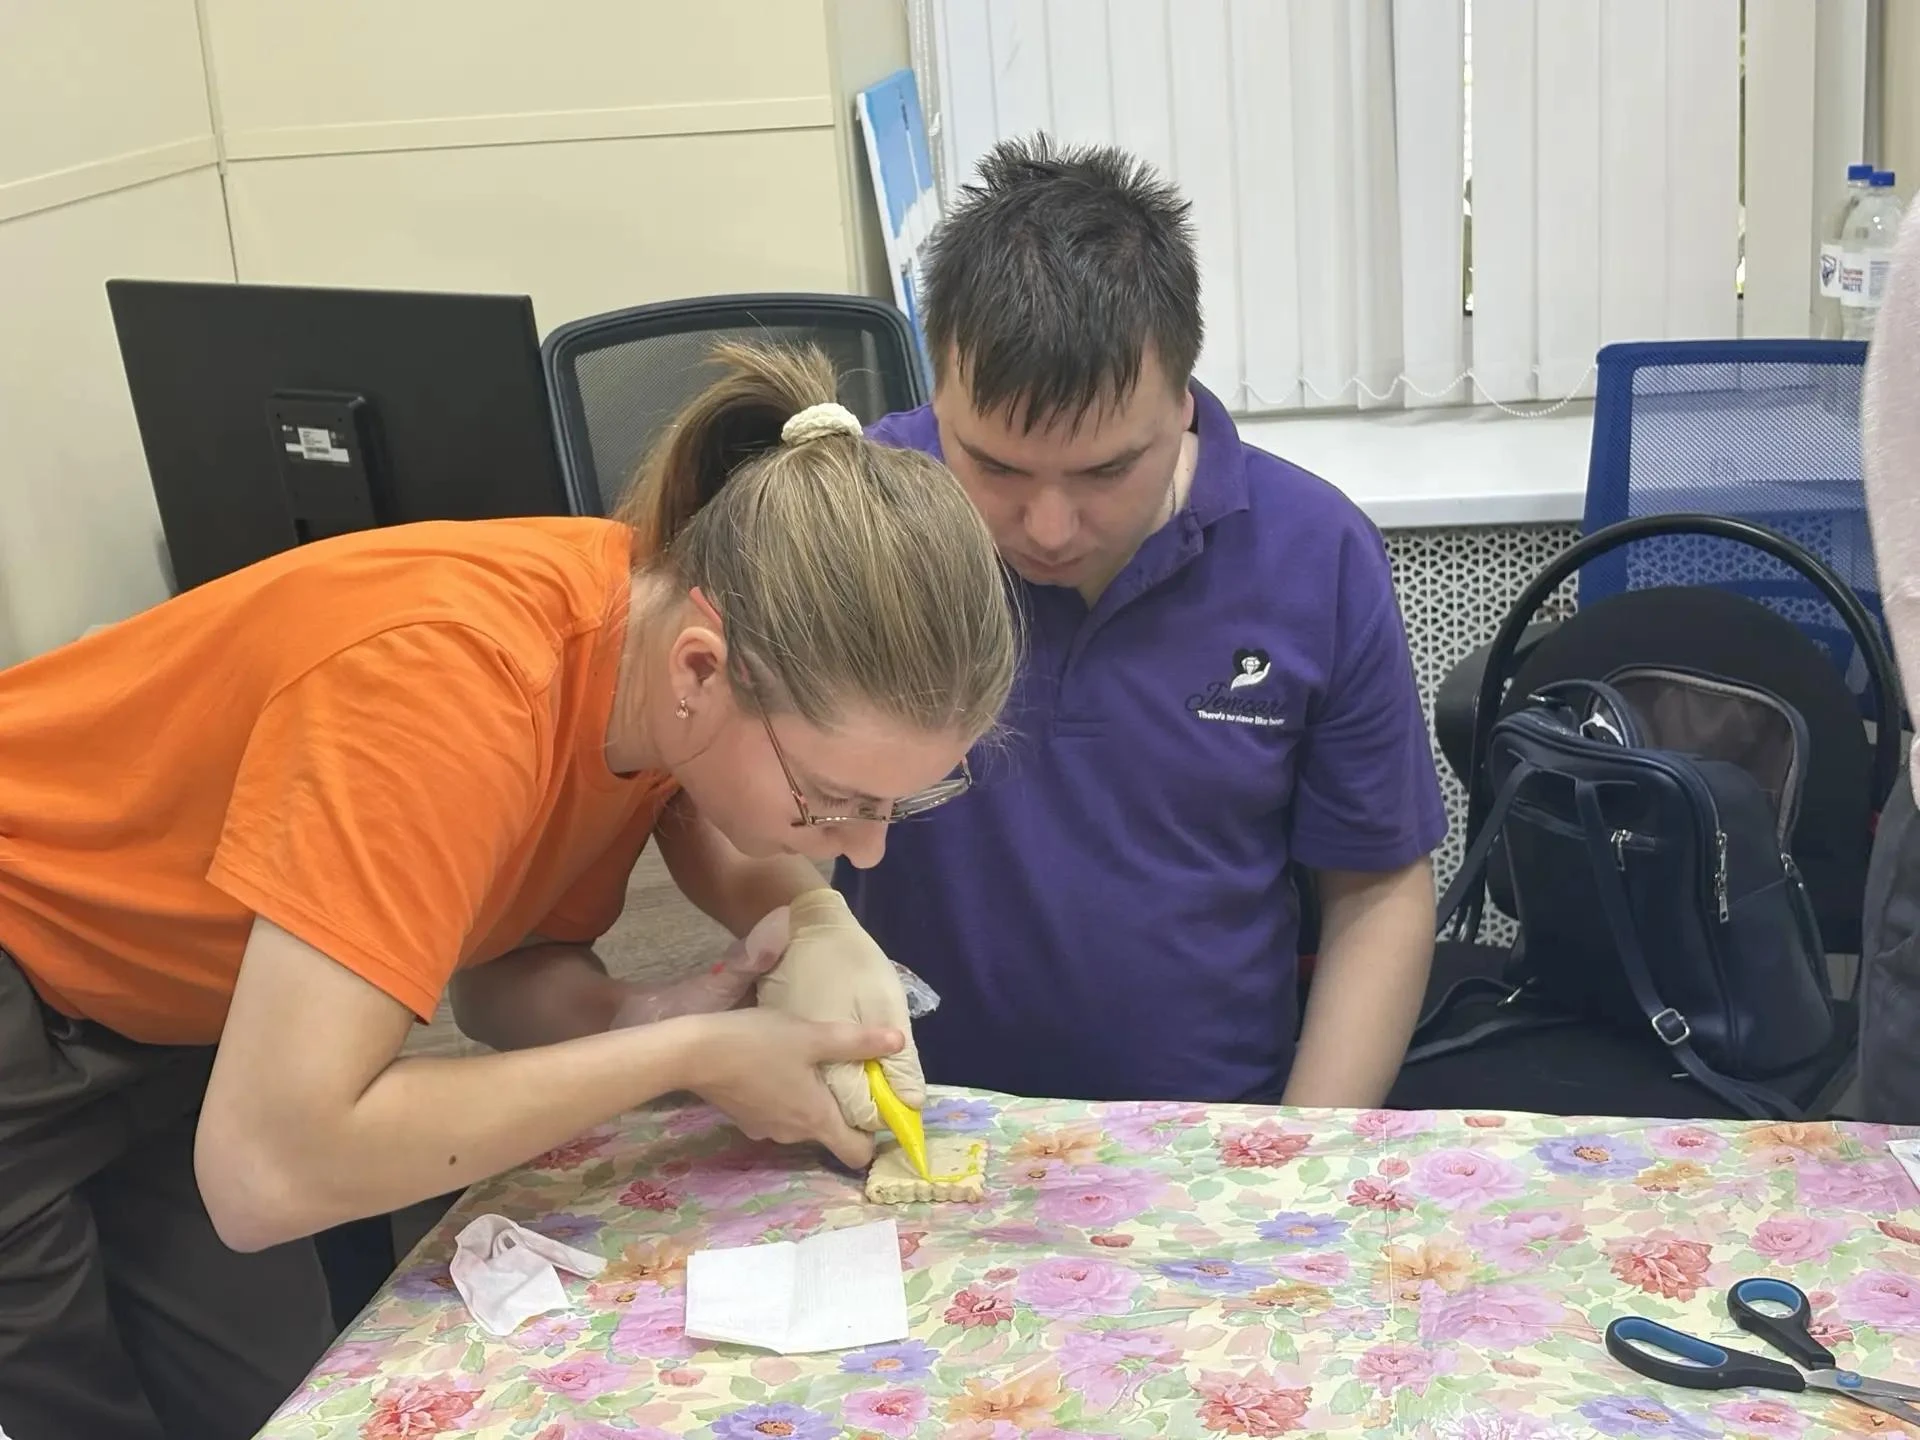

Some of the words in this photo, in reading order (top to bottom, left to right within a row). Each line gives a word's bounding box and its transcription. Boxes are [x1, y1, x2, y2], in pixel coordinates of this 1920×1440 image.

[1197, 710, 1226, 721] There's
[1226, 713, 1236, 721] no
[1254, 715, 1268, 725] like
